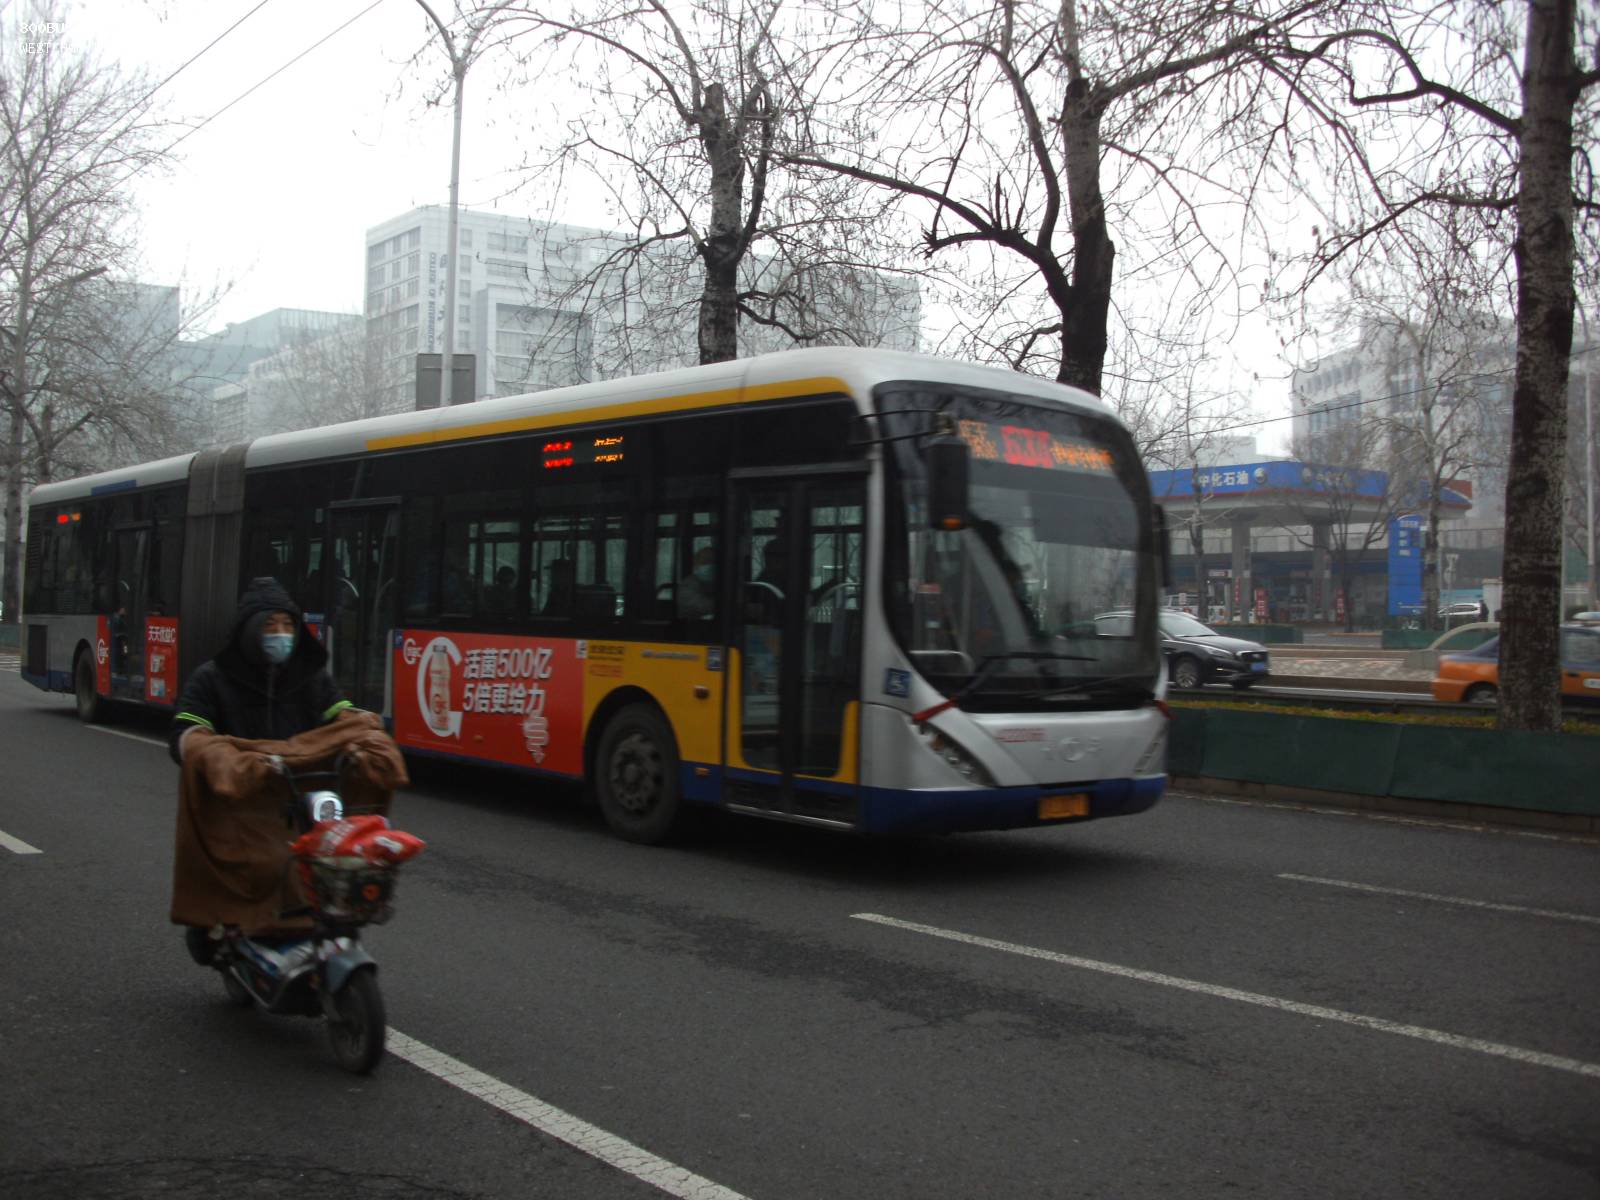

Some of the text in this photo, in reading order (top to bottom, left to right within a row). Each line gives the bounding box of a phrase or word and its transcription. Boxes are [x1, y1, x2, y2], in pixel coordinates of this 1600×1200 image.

[1199, 470, 1249, 488] 中化石油
[462, 648, 553, 679] 活菌500亿
[462, 681, 545, 715] 5倍更给力
